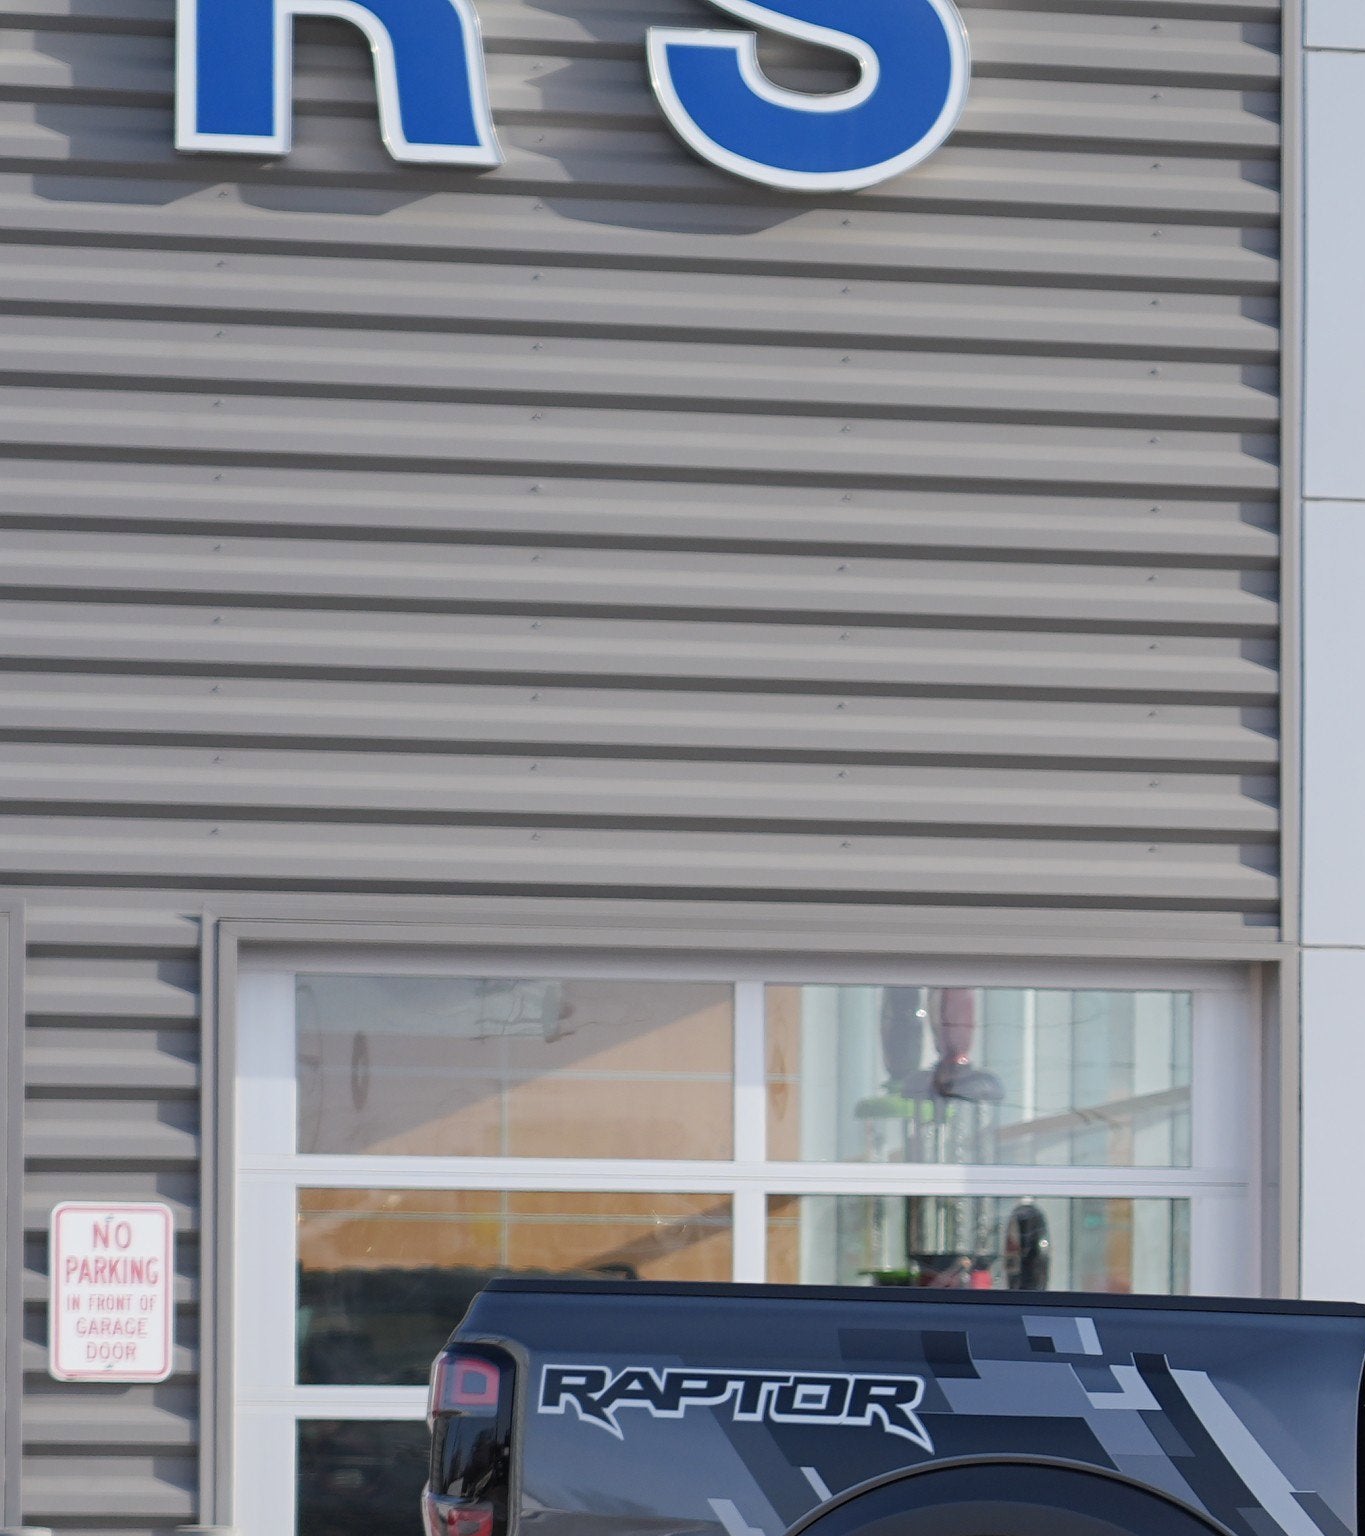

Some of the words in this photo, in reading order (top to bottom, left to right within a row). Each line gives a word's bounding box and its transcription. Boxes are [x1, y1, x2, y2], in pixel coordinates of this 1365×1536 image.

[92, 1220, 133, 1250] NO
[65, 1255, 159, 1285] PARKING
[66, 1294, 81, 1311] IN
[88, 1294, 134, 1312] FRONT
[140, 1294, 157, 1311] OF
[76, 1317, 148, 1338] GARAGE
[86, 1342, 136, 1361] DOOR
[537, 1363, 935, 1456] RAPTOR
